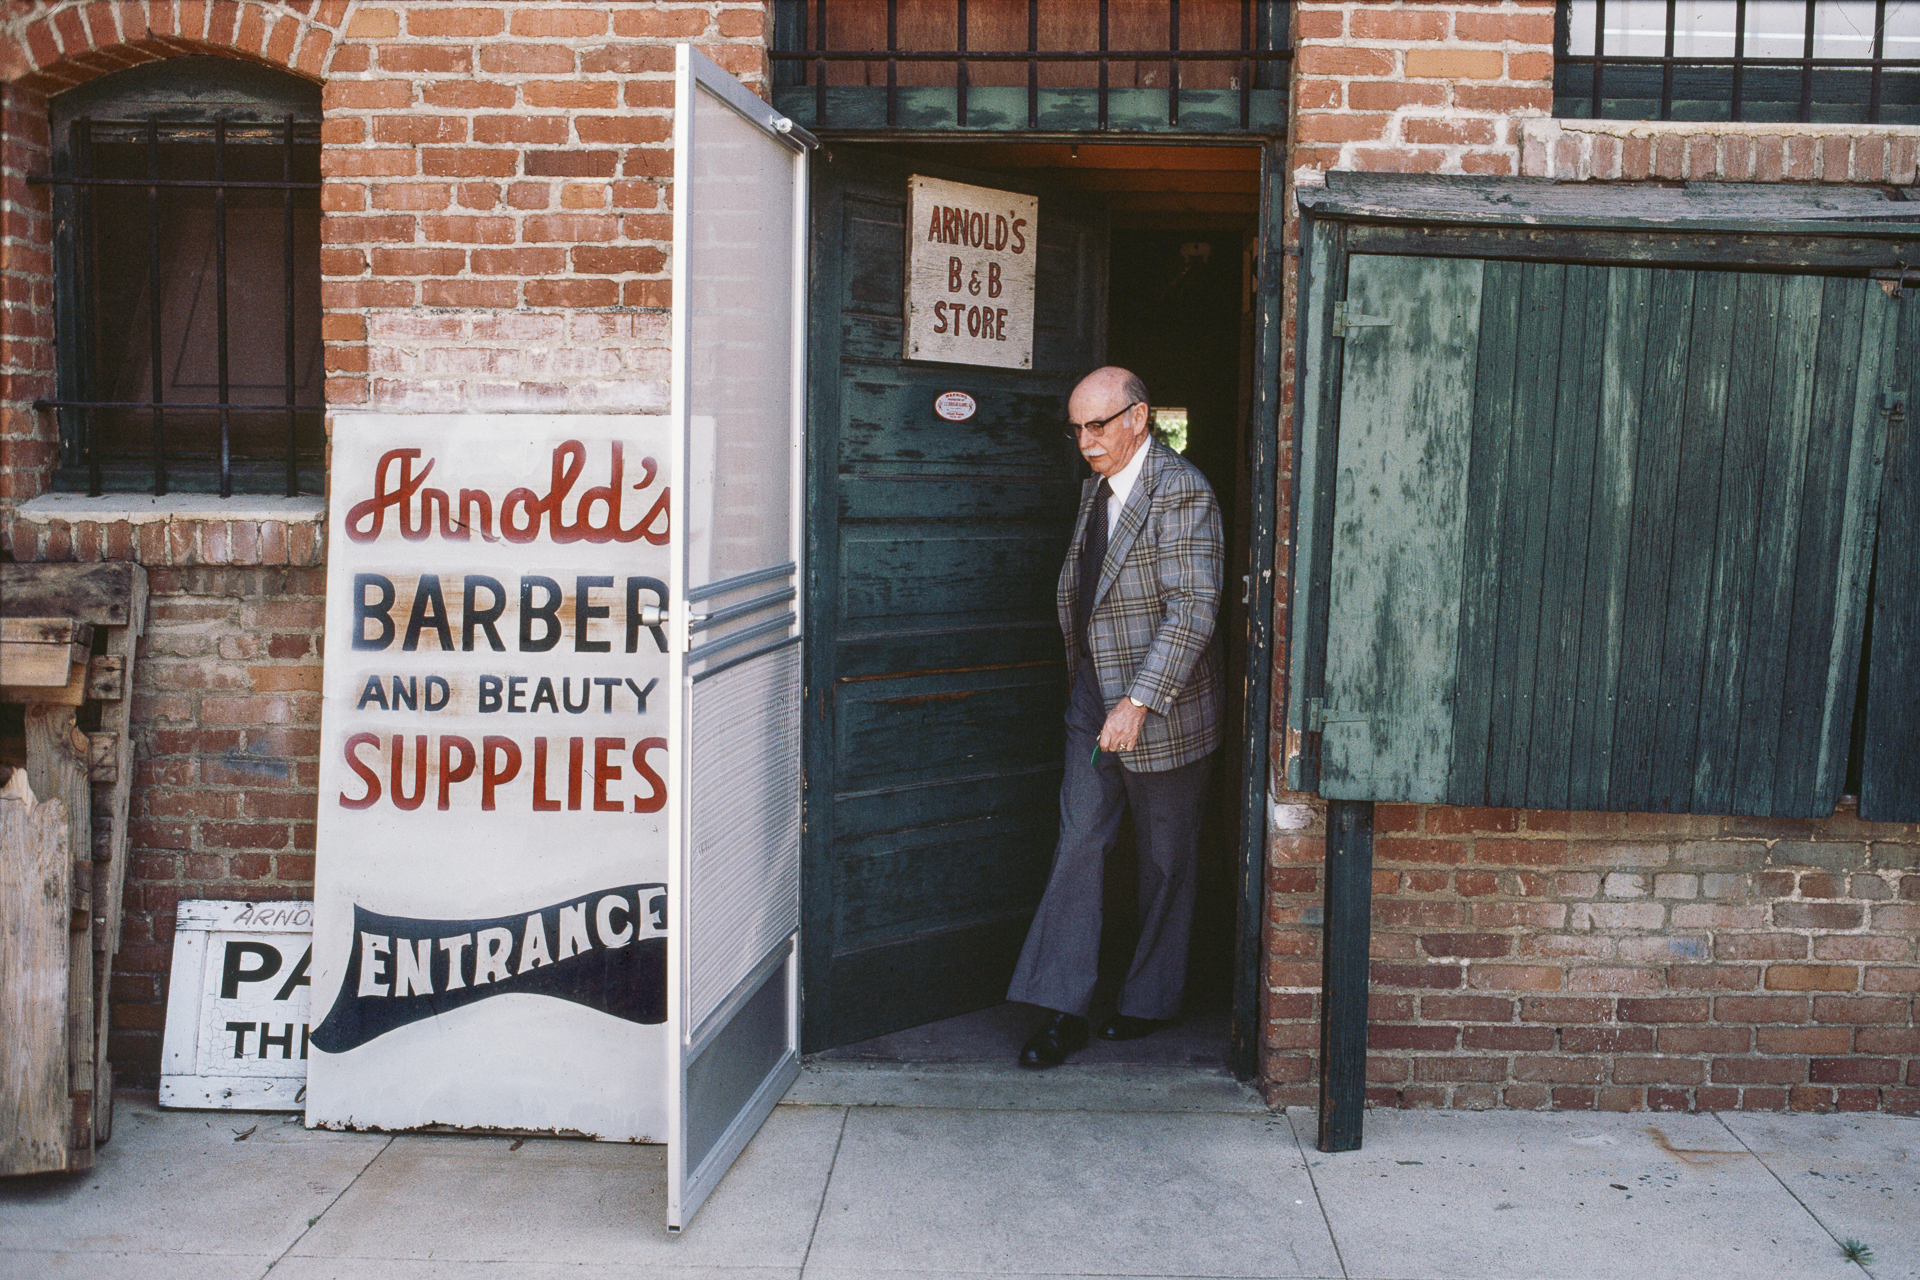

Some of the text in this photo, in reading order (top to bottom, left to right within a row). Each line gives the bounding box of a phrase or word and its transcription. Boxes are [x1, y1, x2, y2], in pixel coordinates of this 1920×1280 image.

[928, 204, 1027, 255] ARNOLD'S
[948, 256, 1002, 299] B & B
[933, 300, 1009, 342] STORE
[345, 439, 671, 546] Arnold's
[351, 573, 670, 654] BARBER
[356, 674, 660, 715] AND BEAUTY
[338, 732, 669, 814] SUPPLIES
[233, 908, 313, 926] ARNO
[357, 886, 668, 998] ENTRANCE
